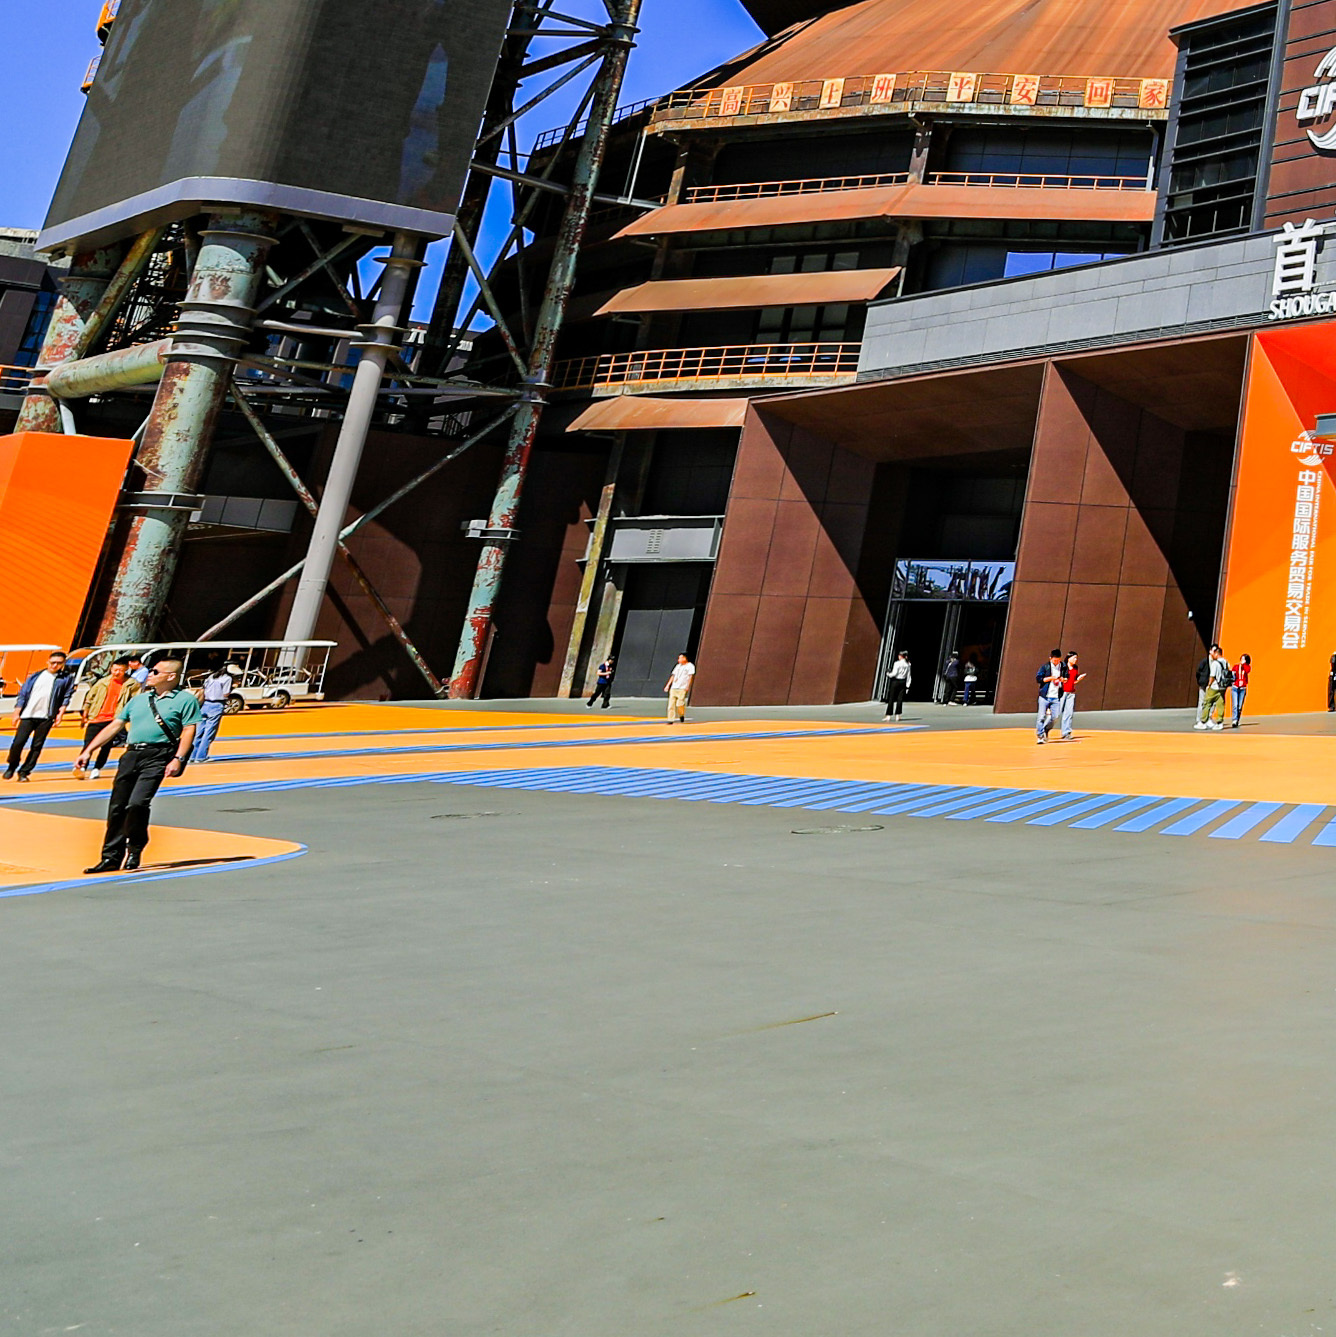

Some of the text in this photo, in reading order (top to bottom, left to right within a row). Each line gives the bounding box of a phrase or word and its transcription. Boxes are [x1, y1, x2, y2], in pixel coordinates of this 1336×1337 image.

[1290, 440, 1335, 455] CIFTIS
[1281, 469, 1317, 649] 中国国际服务贸易交易会
